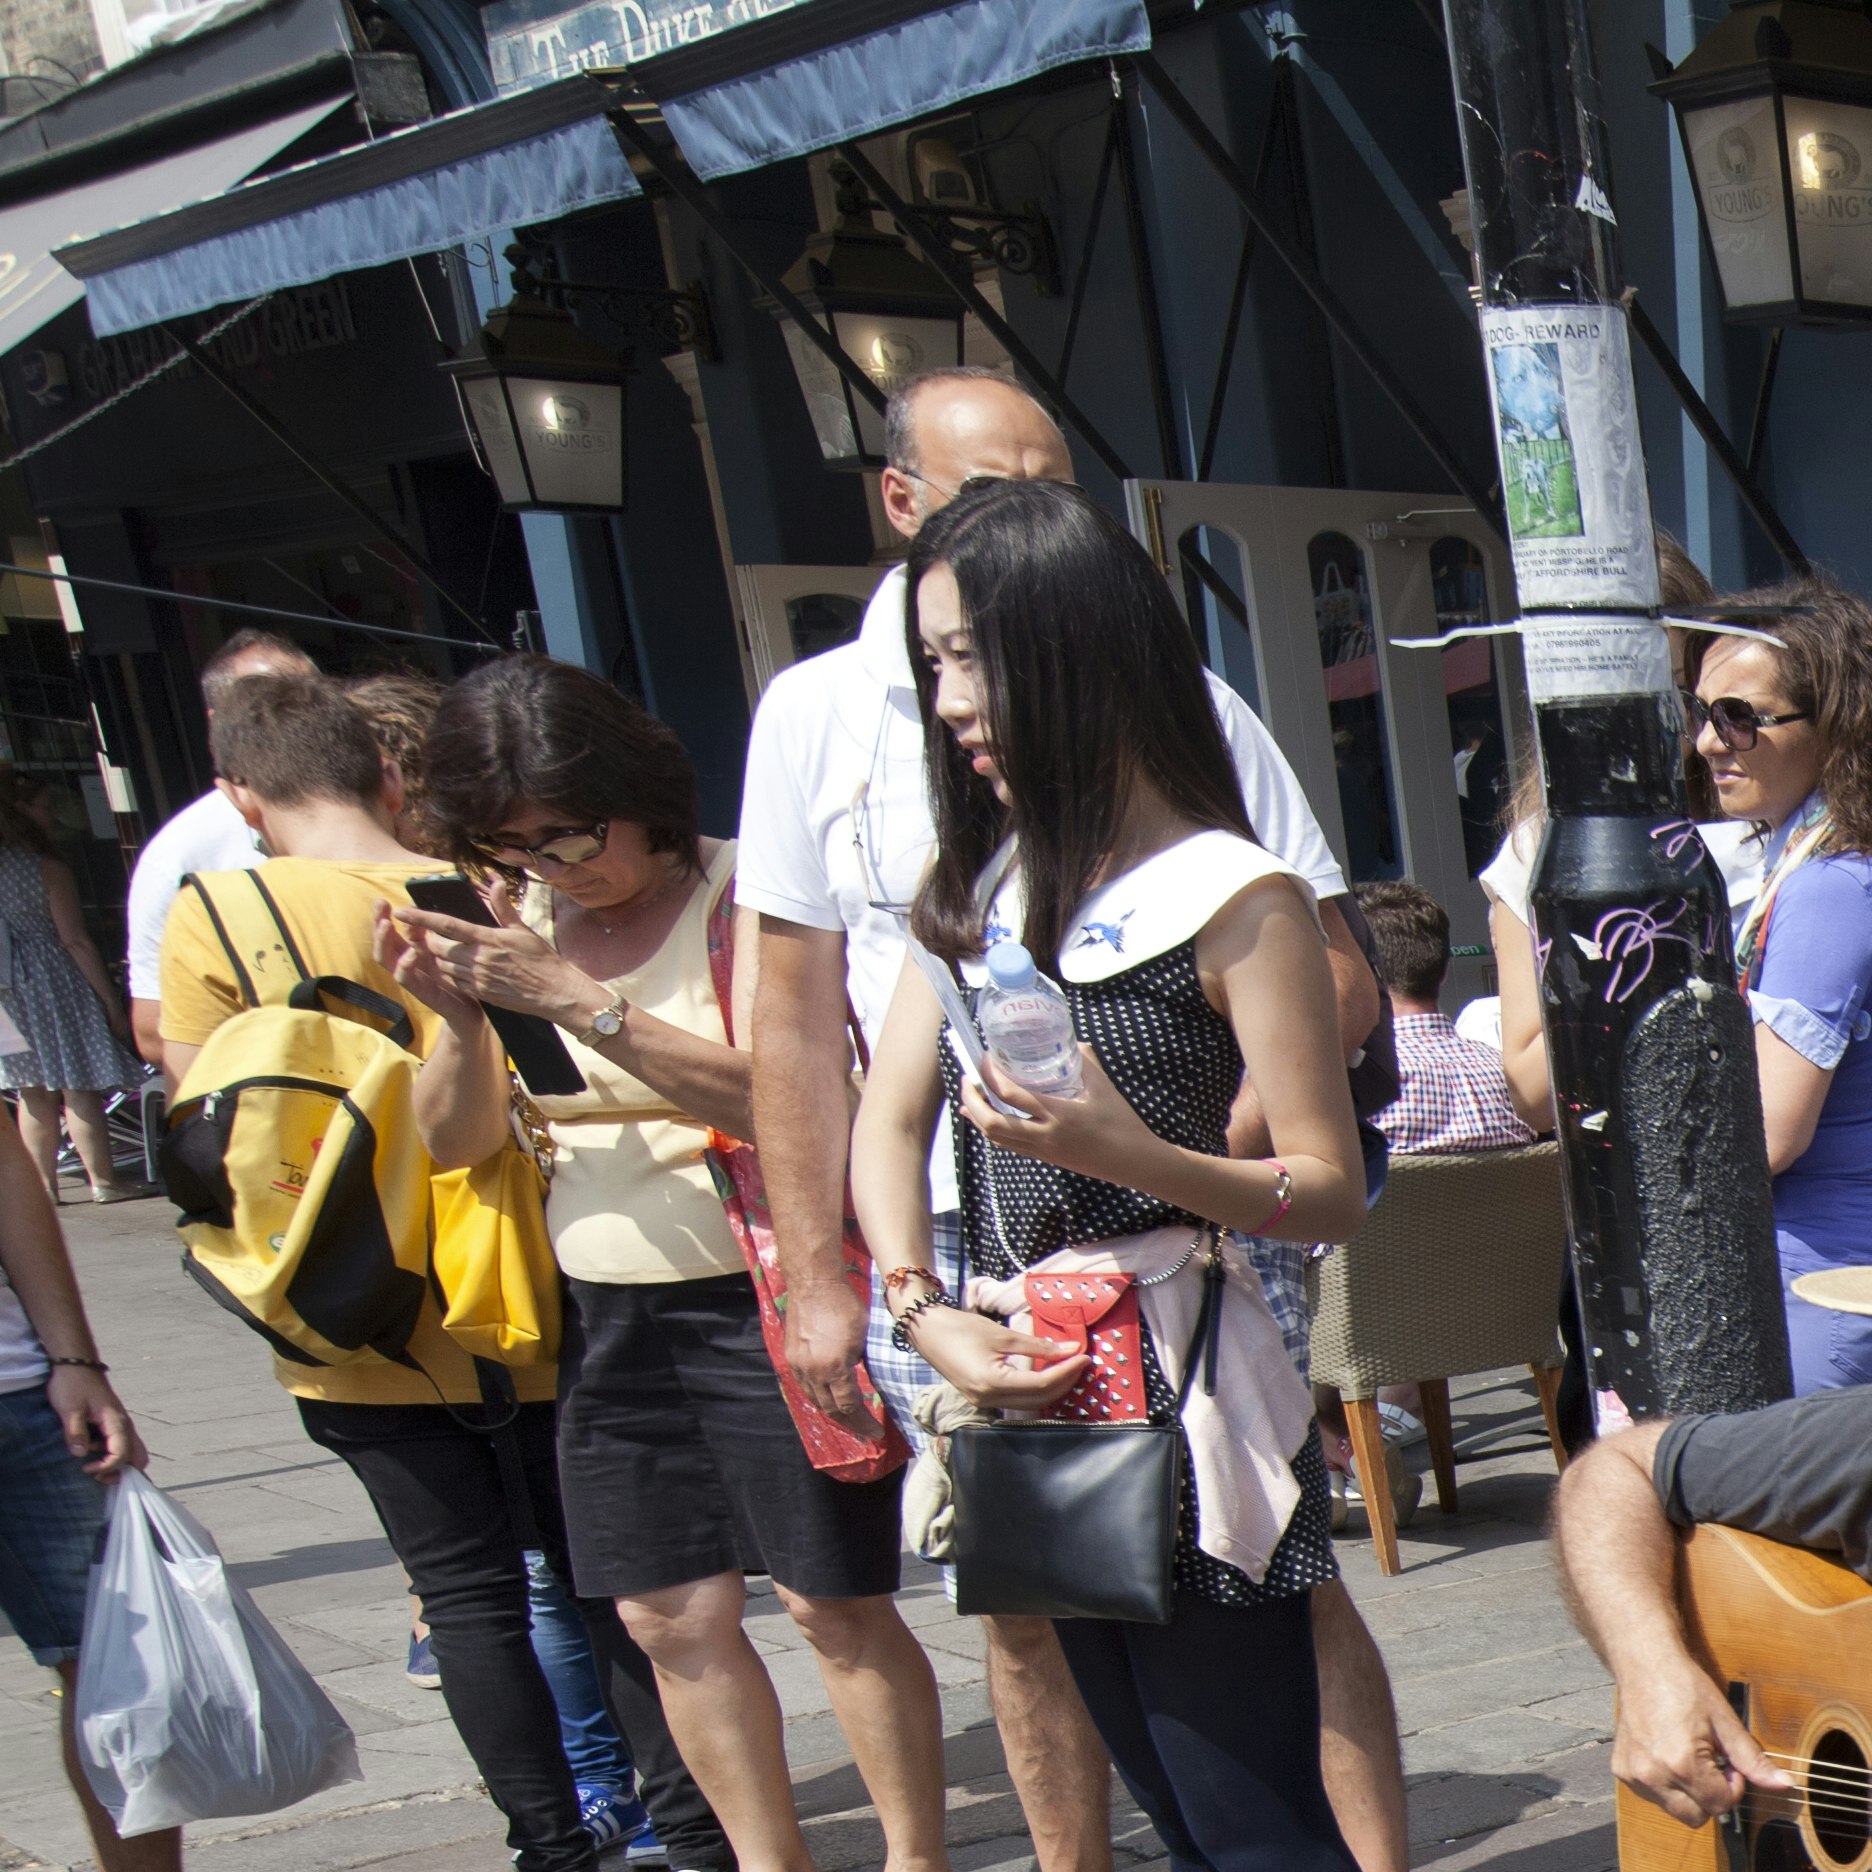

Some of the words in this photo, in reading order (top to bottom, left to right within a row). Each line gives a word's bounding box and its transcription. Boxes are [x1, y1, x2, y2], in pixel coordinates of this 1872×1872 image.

[1525, 323, 1600, 340] REWARD
[536, 431, 607, 449] YOUNG'S
[1450, 944, 1480, 957] pen
